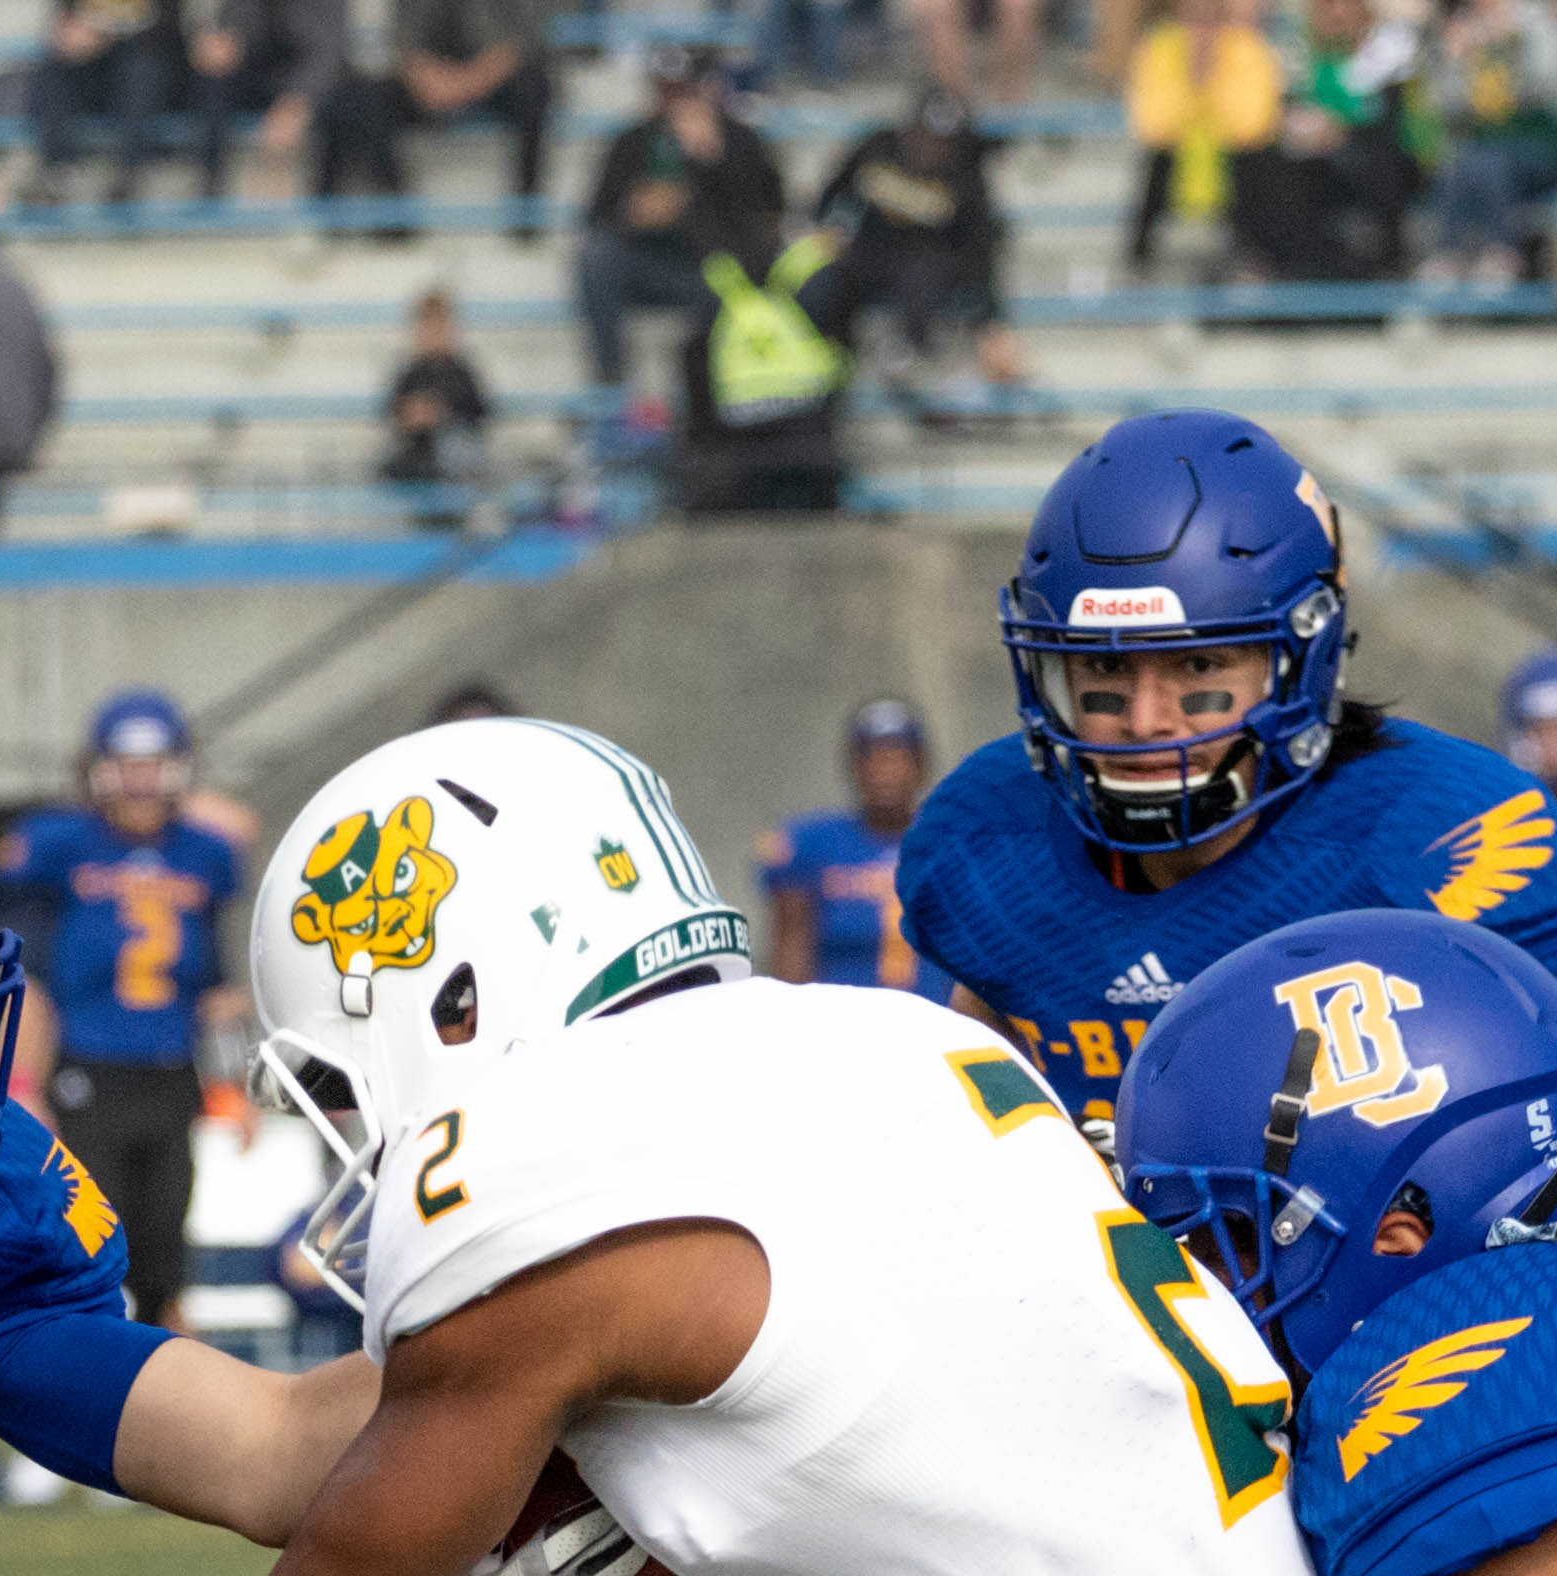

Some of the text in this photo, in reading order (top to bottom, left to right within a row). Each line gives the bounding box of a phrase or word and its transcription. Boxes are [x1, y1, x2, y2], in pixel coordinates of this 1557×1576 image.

[1082, 597, 1163, 616] Riddell
[636, 916, 733, 977] GOLDEN
[414, 1107, 471, 1226] 2
